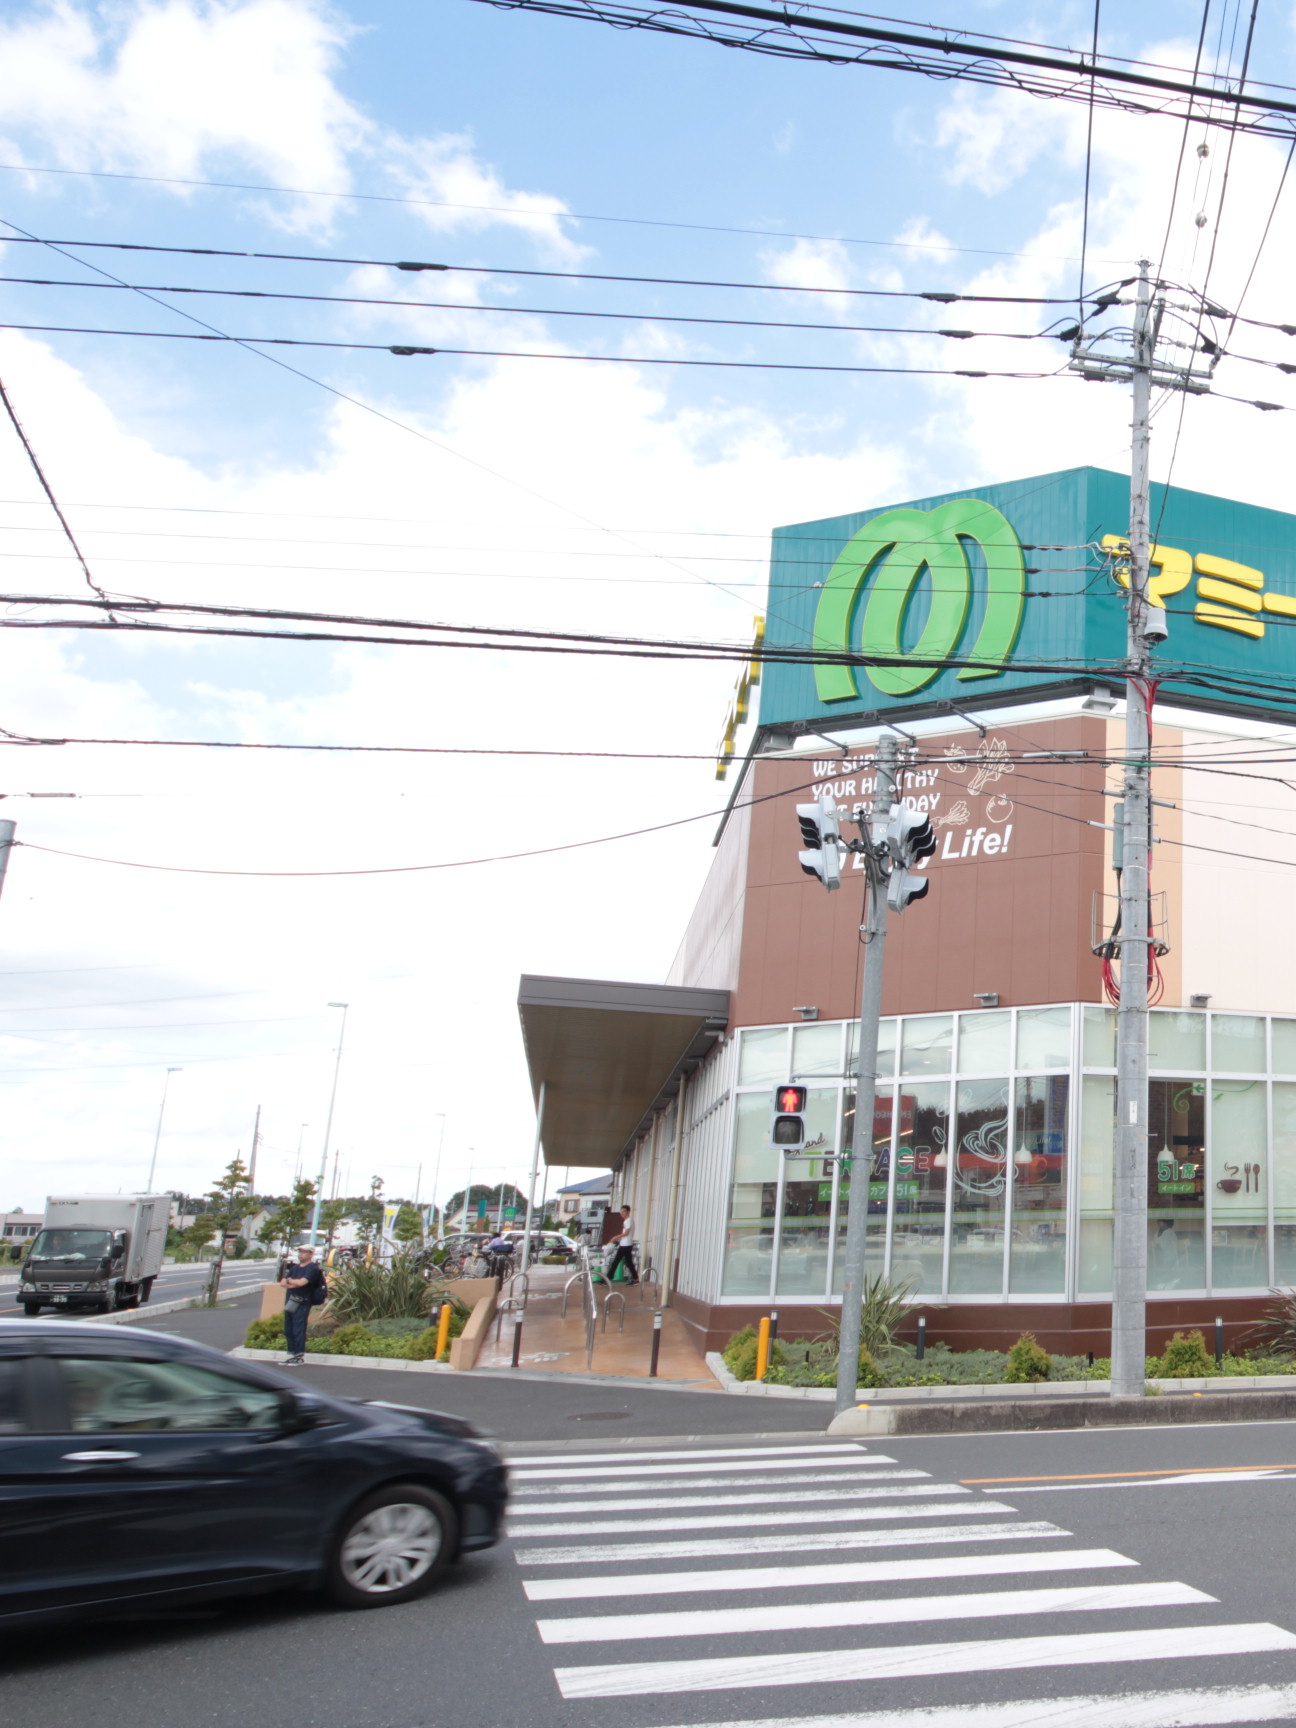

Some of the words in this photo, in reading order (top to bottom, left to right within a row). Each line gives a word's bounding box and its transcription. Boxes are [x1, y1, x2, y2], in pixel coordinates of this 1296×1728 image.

[813, 757, 837, 777] WE
[812, 779, 856, 800] YOUR
[941, 824, 1013, 860] Life!
[804, 1146, 931, 1177] TERACE
[1157, 1160, 1196, 1181] 51席
